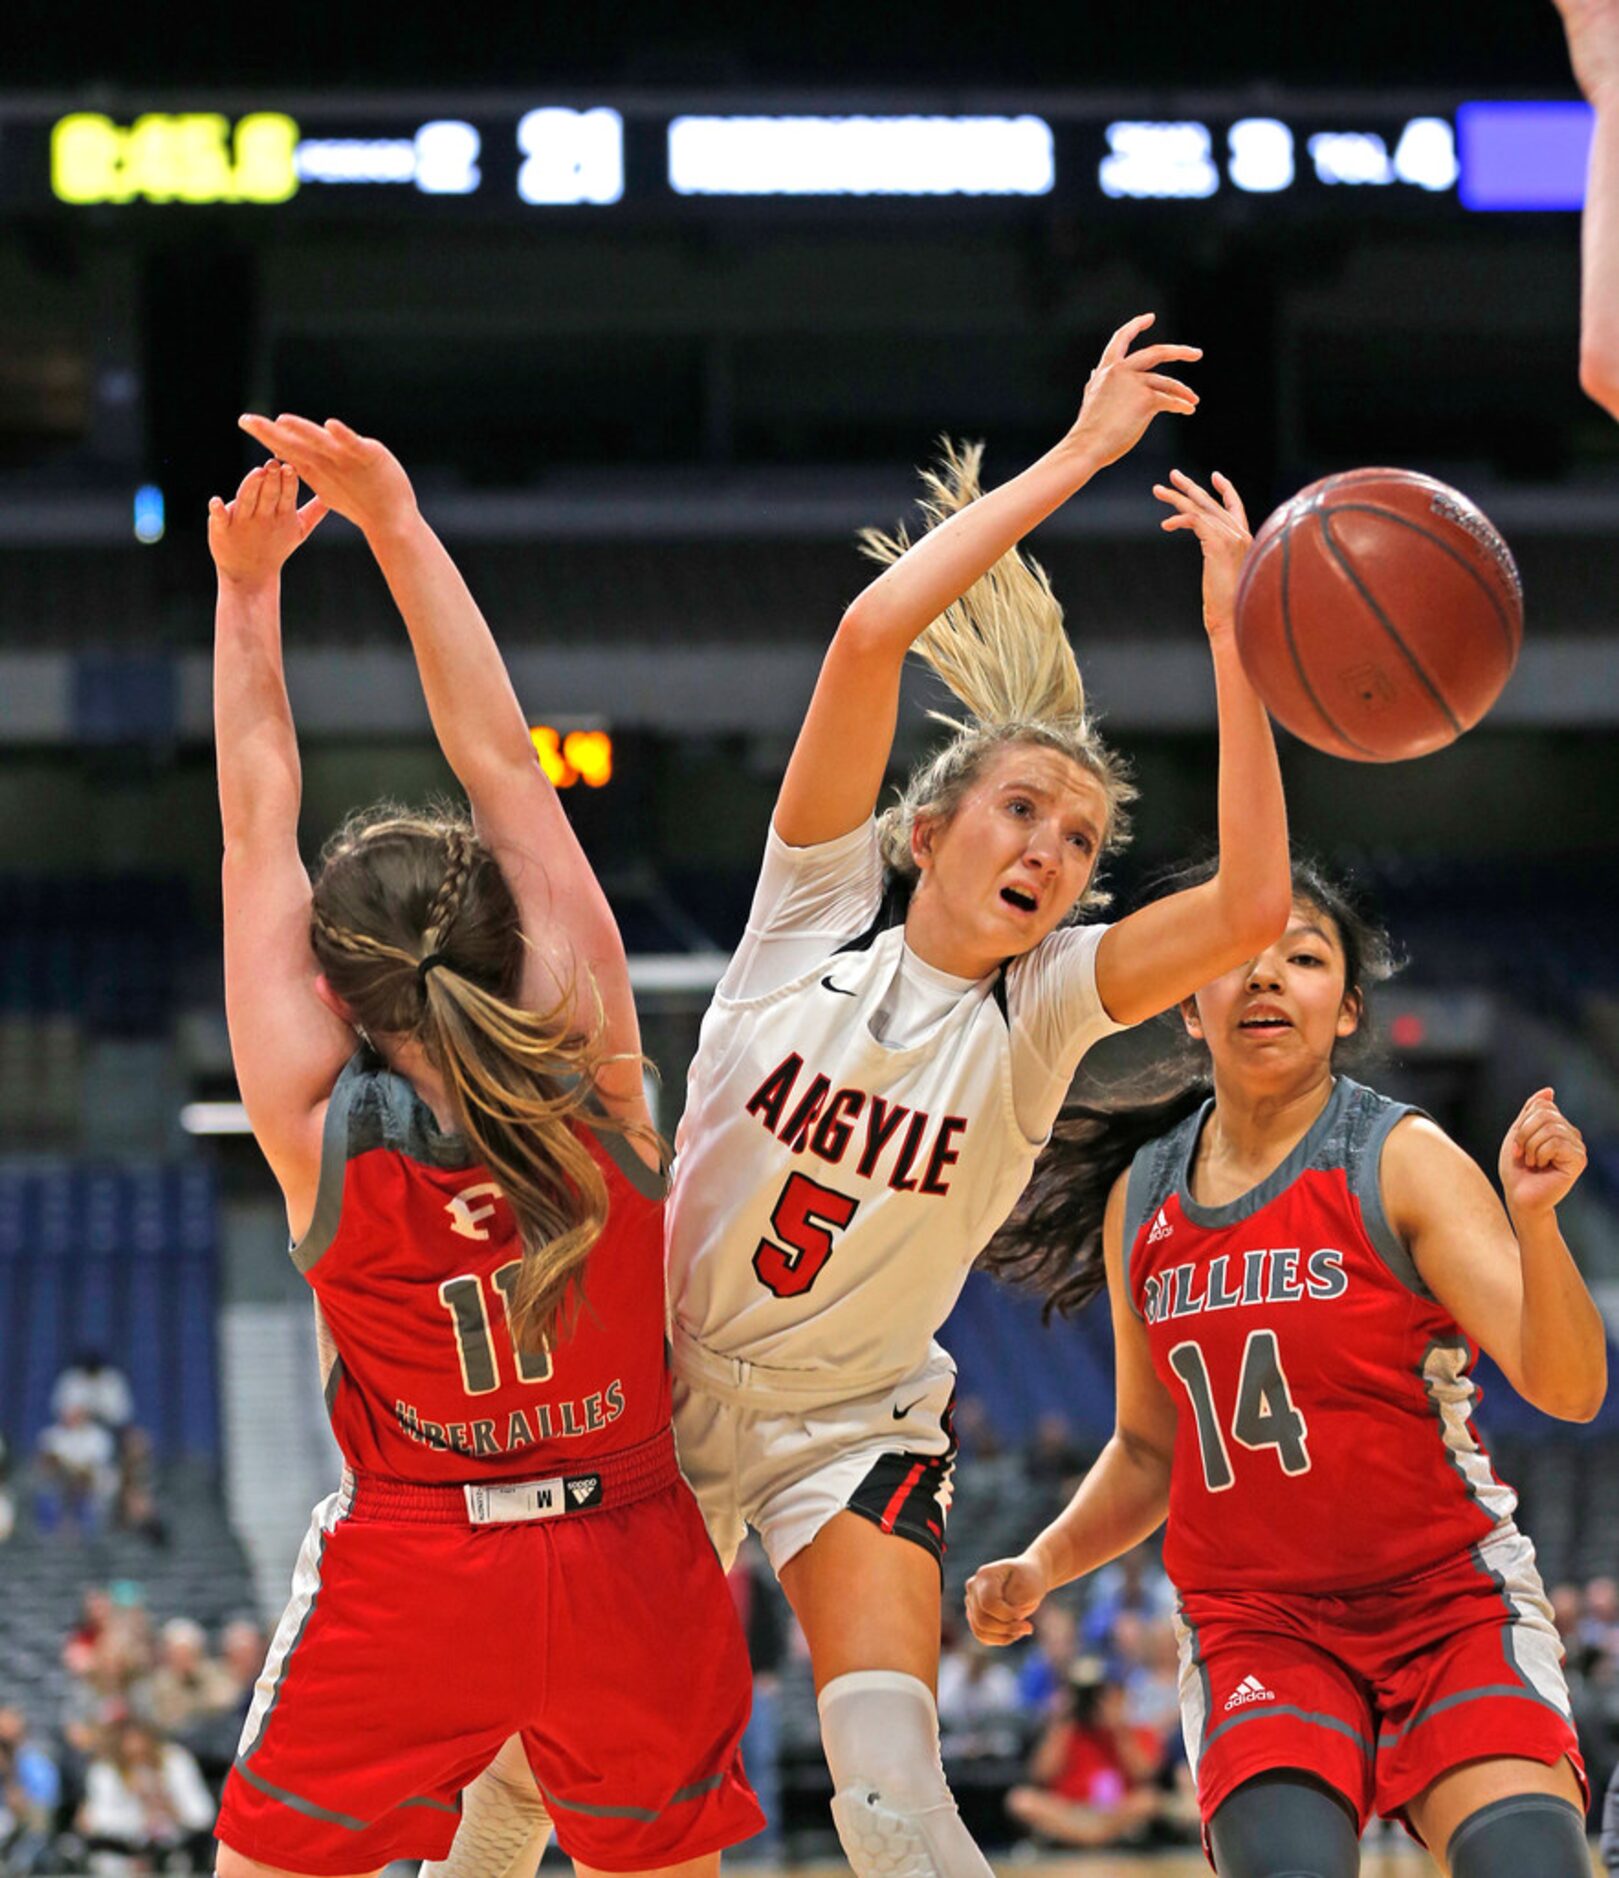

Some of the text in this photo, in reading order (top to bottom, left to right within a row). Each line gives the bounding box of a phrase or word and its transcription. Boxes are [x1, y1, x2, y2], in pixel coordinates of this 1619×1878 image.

[745, 1051, 968, 1196] ARGYLE
[751, 1170, 860, 1299] 5
[1143, 1248, 1348, 1324] BILLIES
[439, 1259, 554, 1397] 11
[1168, 1328, 1312, 1493] 14
[1224, 1690, 1276, 1712] adidas
